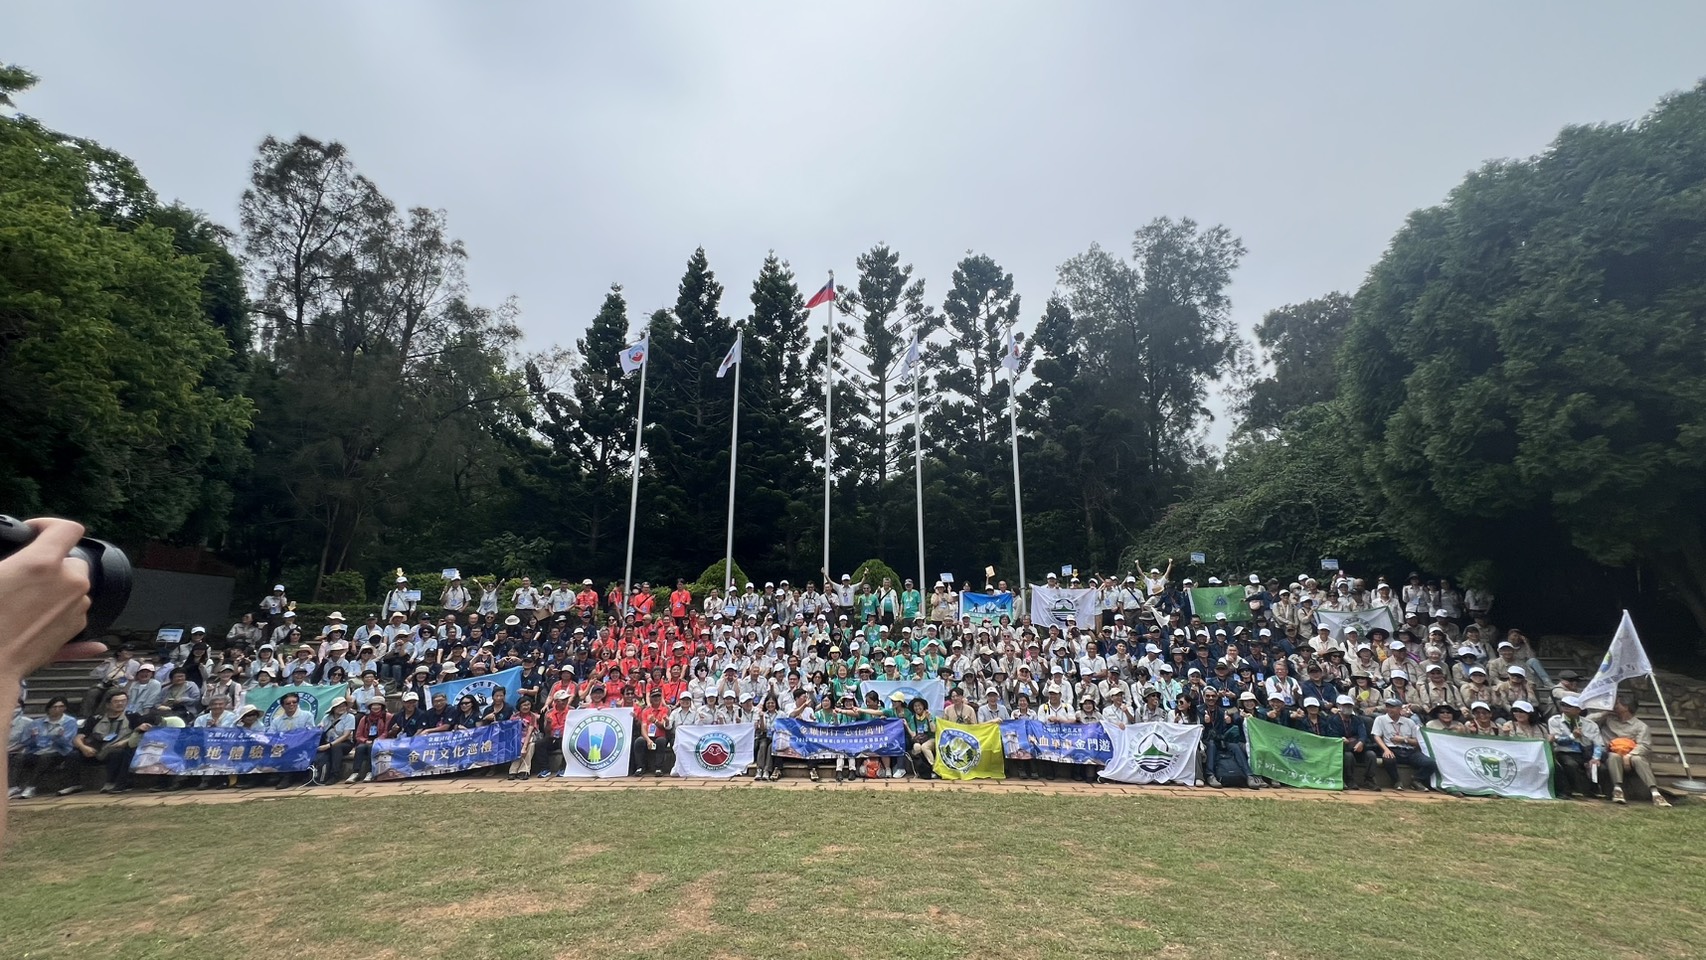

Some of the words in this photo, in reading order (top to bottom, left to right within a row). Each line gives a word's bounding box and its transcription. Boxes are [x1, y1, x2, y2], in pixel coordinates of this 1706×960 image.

[184, 743, 287, 760] 戰地體驗營
[408, 740, 493, 763] 金門文化巡禮
